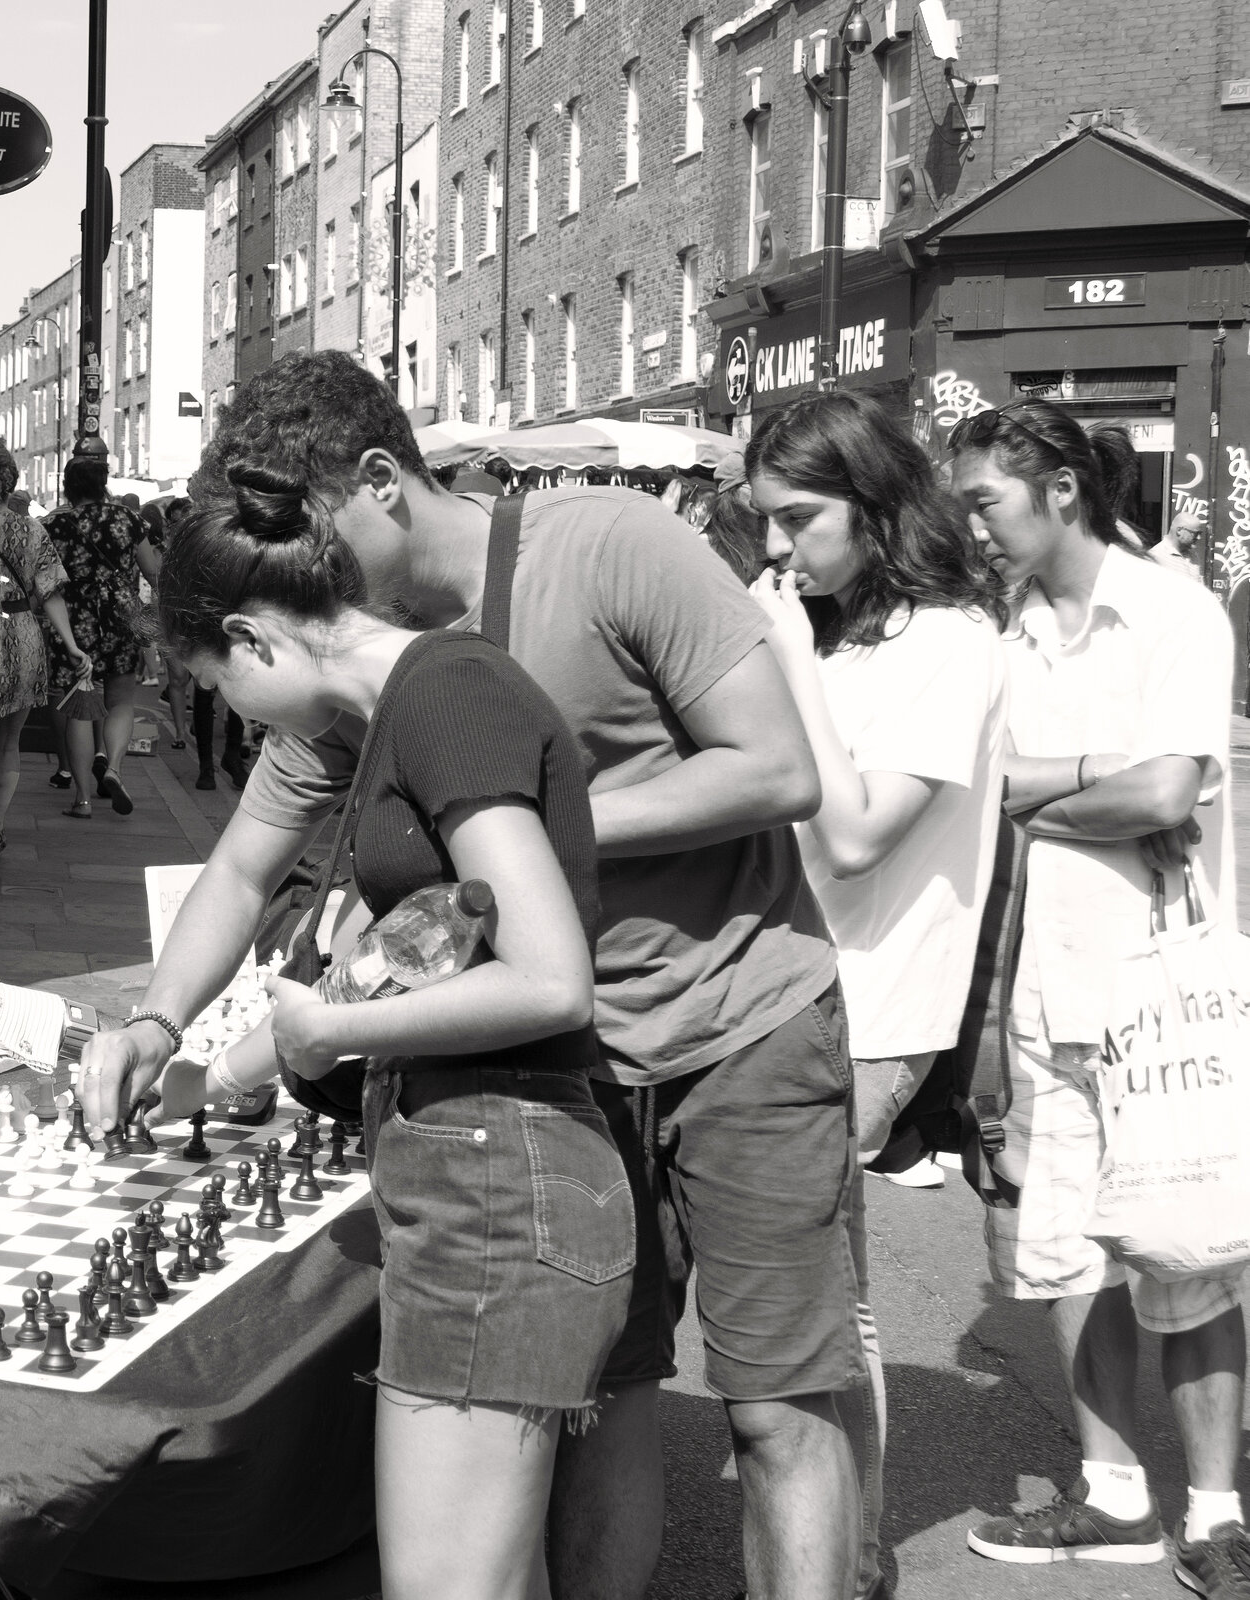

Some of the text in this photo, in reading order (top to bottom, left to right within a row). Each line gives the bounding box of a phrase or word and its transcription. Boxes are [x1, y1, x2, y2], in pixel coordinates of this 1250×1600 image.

[849, 201, 878, 211] CCTV
[1068, 278, 1126, 304] 182
[753, 345, 776, 394] CK
[777, 336, 816, 389] LANE
[160, 890, 187, 913] CHE
[376, 981, 404, 999] Vittel
